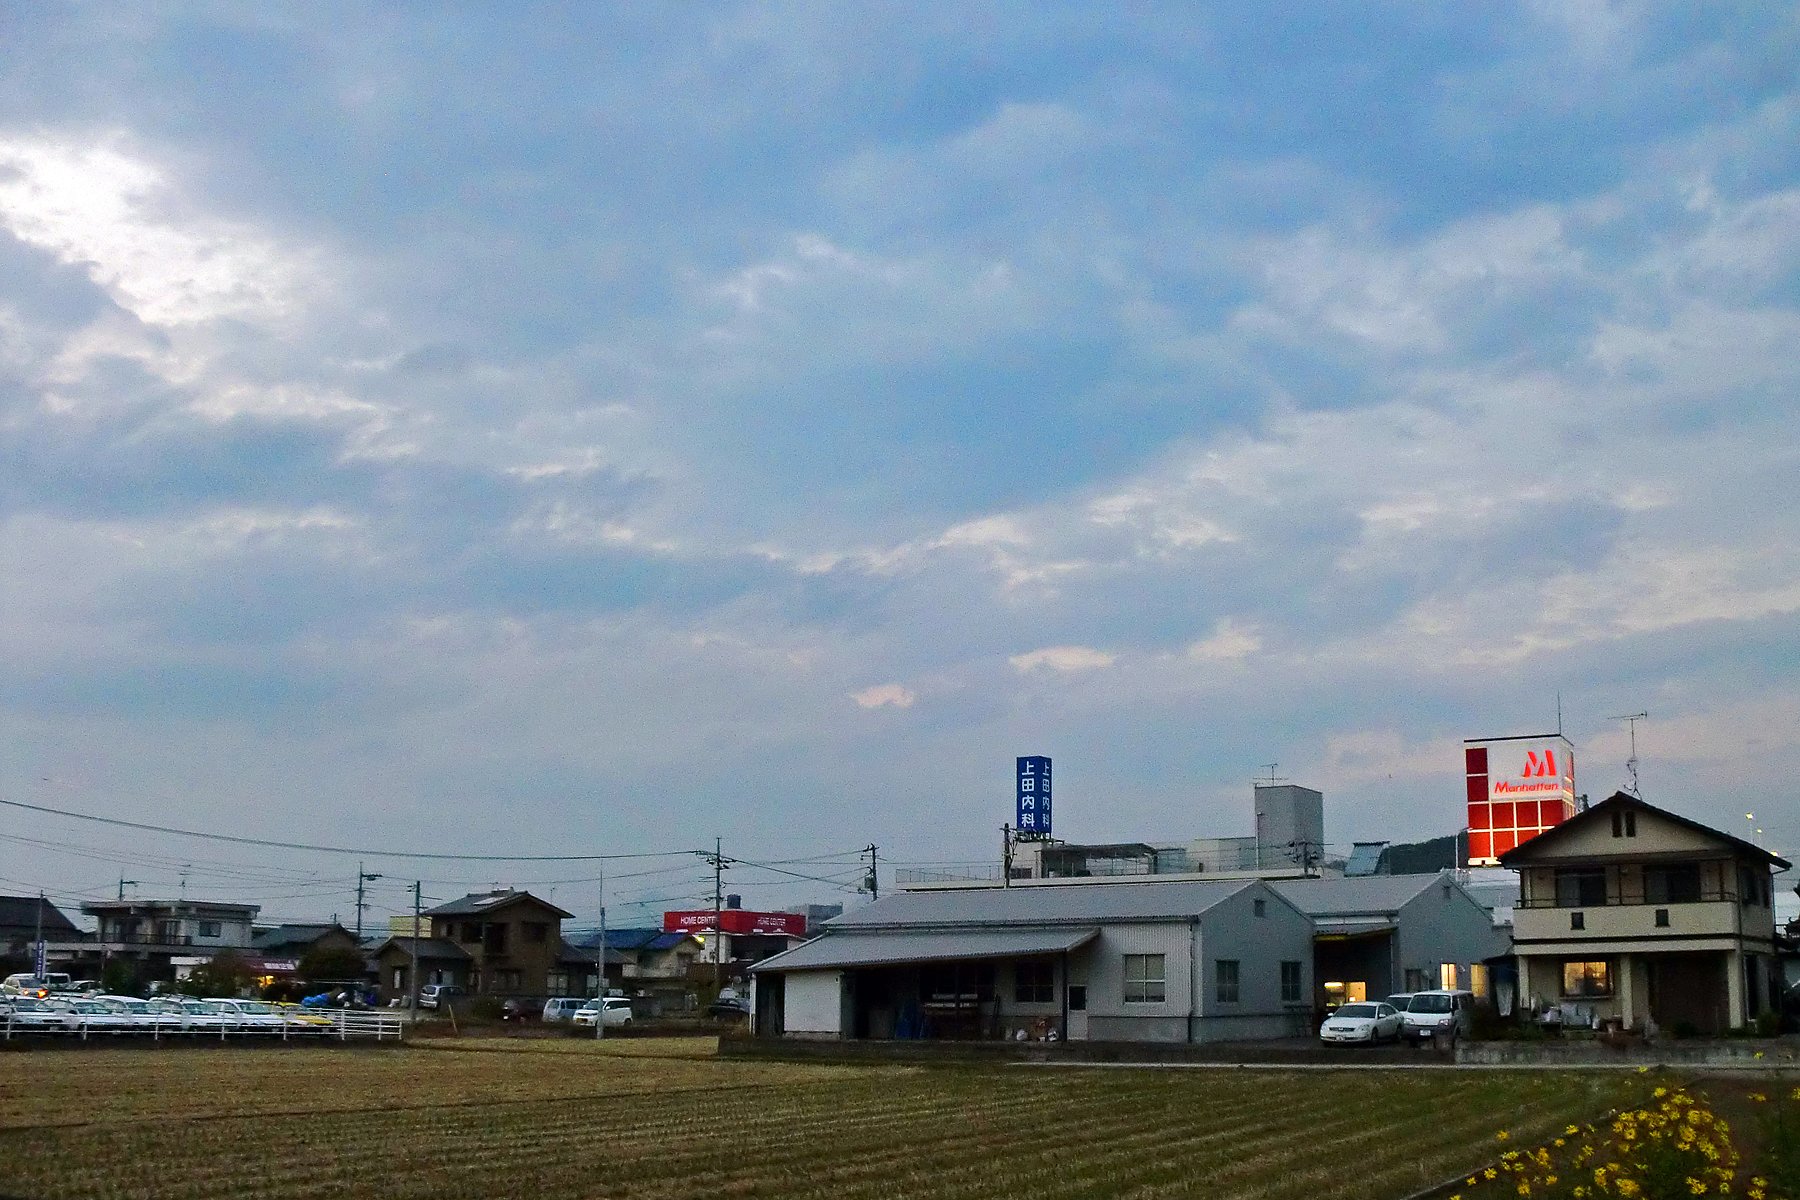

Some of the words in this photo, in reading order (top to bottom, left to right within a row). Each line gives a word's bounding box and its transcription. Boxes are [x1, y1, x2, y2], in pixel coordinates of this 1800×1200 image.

[1021, 760, 1035, 828] 上田内科
[1042, 761, 1050, 828] 上田内科
[1494, 781, 1559, 794] Manhattan
[680, 916, 697, 925] HOME
[697, 916, 718, 924] CENTE
